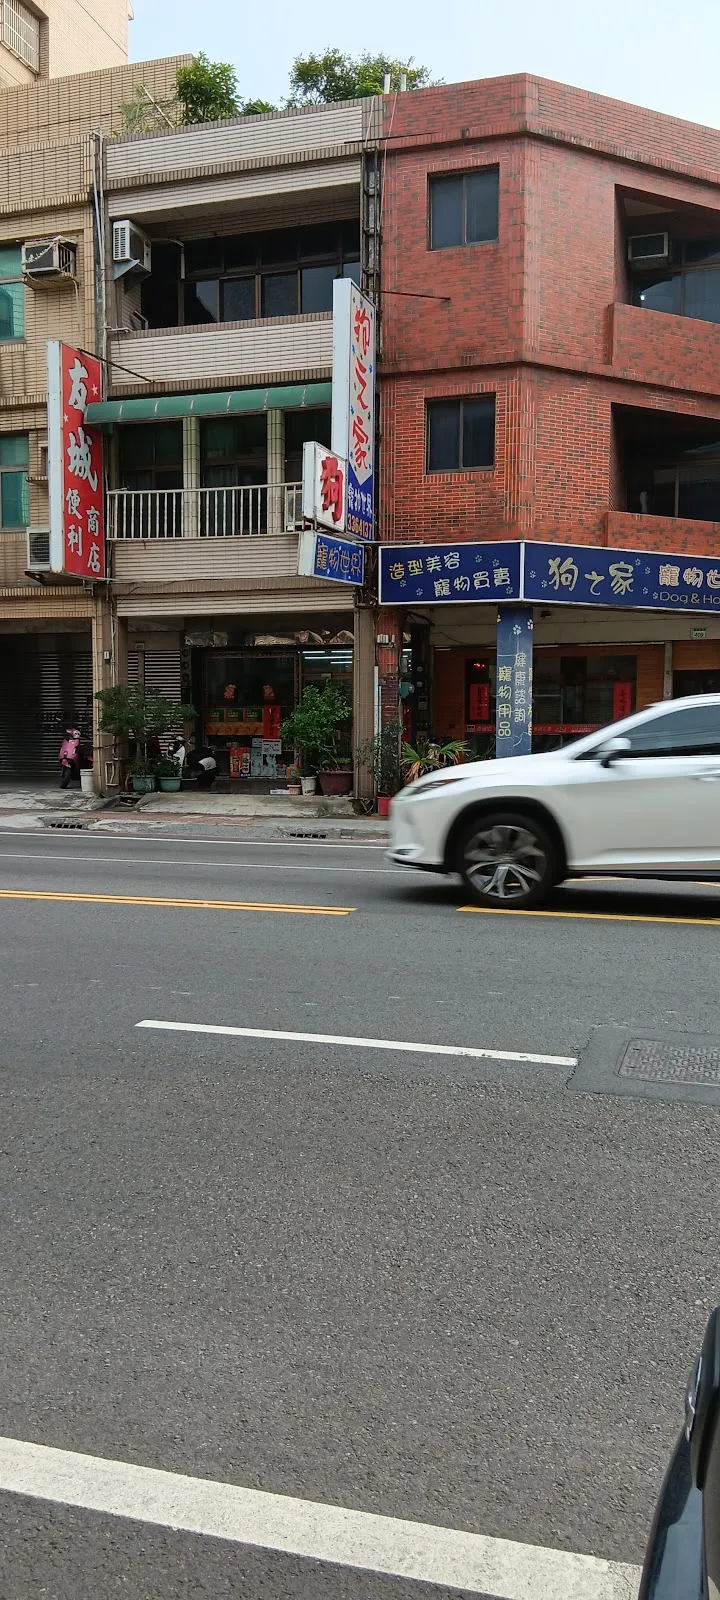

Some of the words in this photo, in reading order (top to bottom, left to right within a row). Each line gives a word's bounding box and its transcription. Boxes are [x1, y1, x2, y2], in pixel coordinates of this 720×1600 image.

[320, 456, 344, 524] 狗
[66, 487, 83, 557] 便利
[86, 506, 100, 573] 商店
[347, 513, 373, 540] 3364137
[316, 541, 362, 577] 寵物世界
[389, 551, 461, 581] 造型美容
[547, 556, 635, 596] 狗之家
[433, 567, 511, 598] 寵物買賣
[659, 591, 688, 604] Dog
[691, 593, 700, 604] &
[498, 665, 513, 737] 寵物用品
